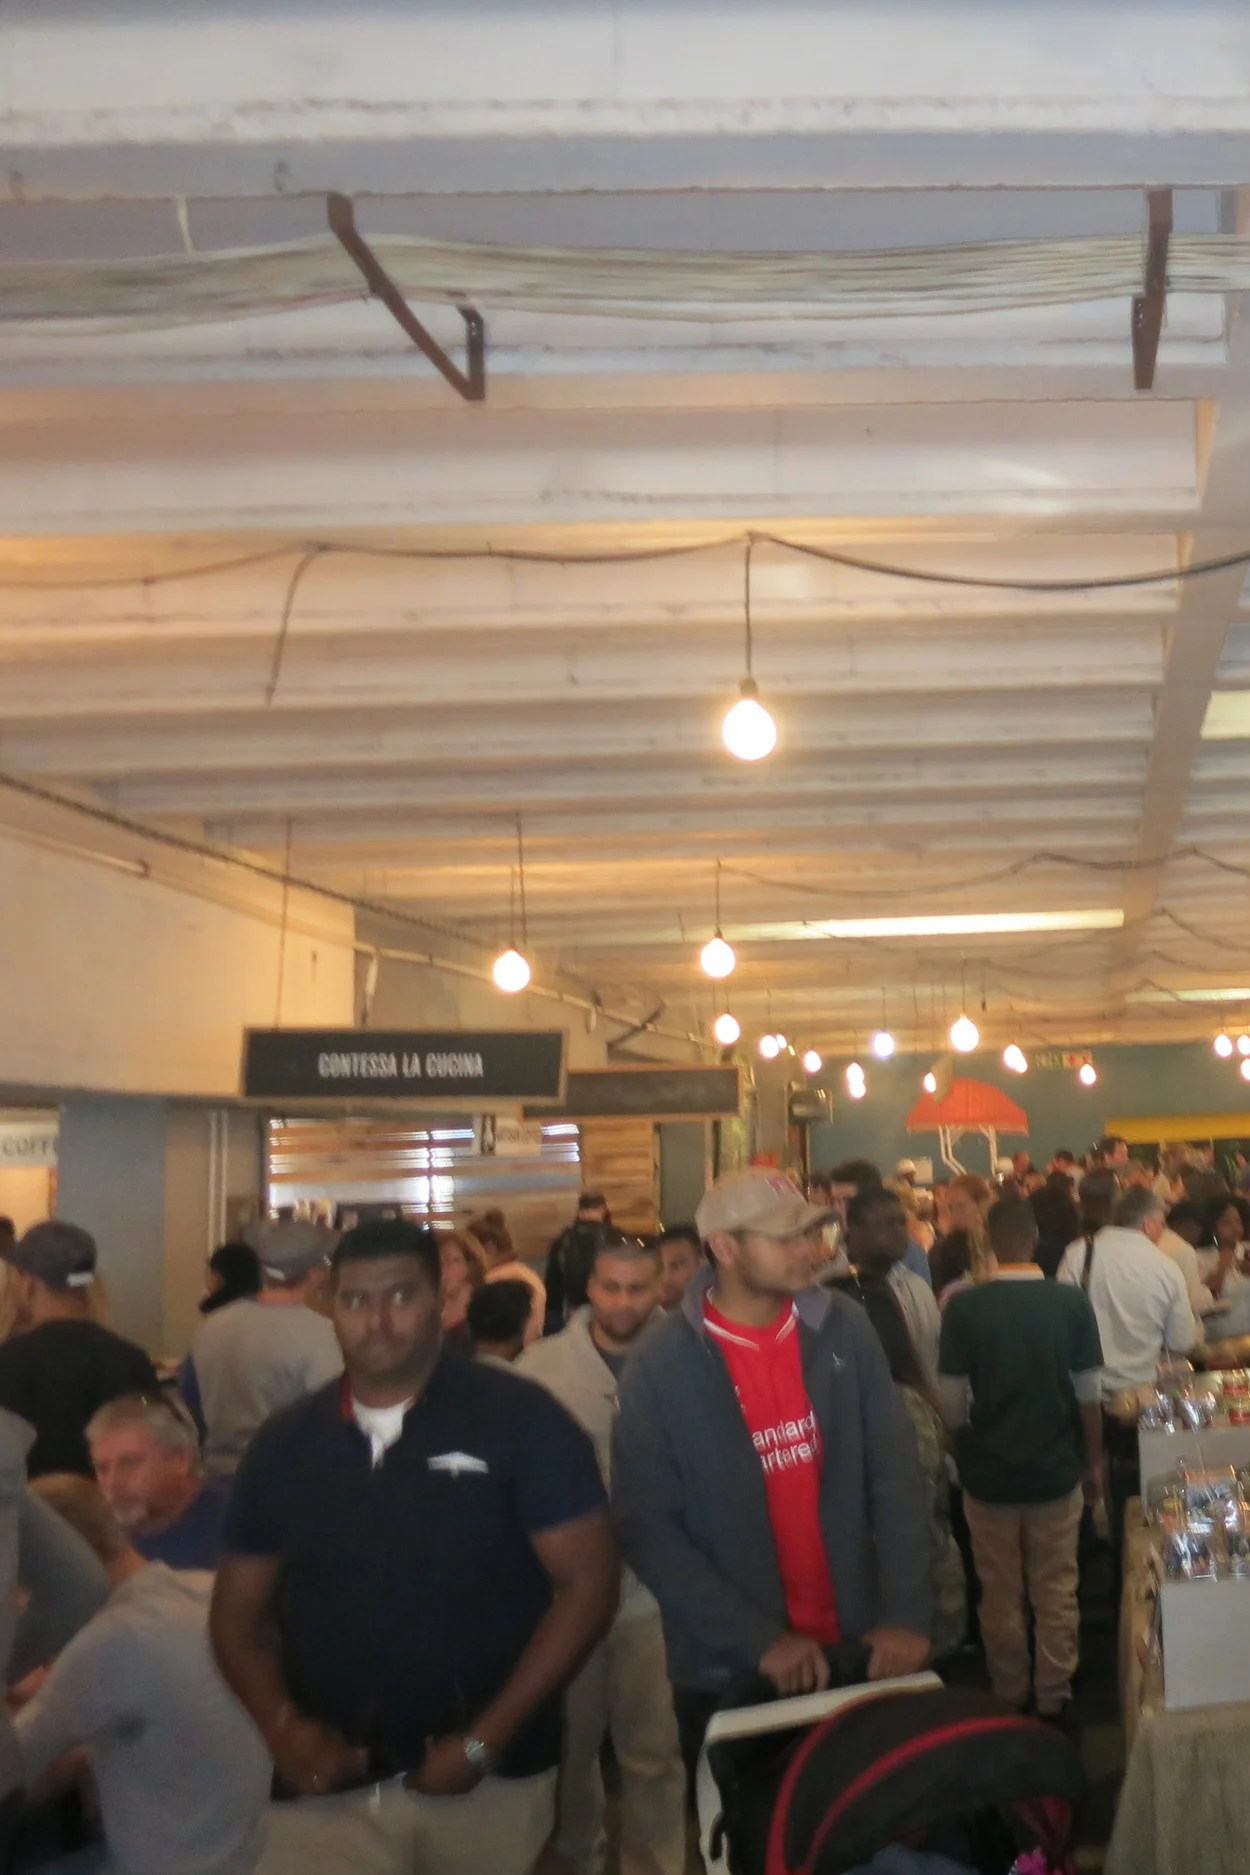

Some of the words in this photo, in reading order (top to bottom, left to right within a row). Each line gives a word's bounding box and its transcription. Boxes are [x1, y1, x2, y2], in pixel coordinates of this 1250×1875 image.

[317, 1052, 399, 1078] CONTESSA
[402, 1052, 421, 1078] LA
[425, 1052, 485, 1077] CUCINA
